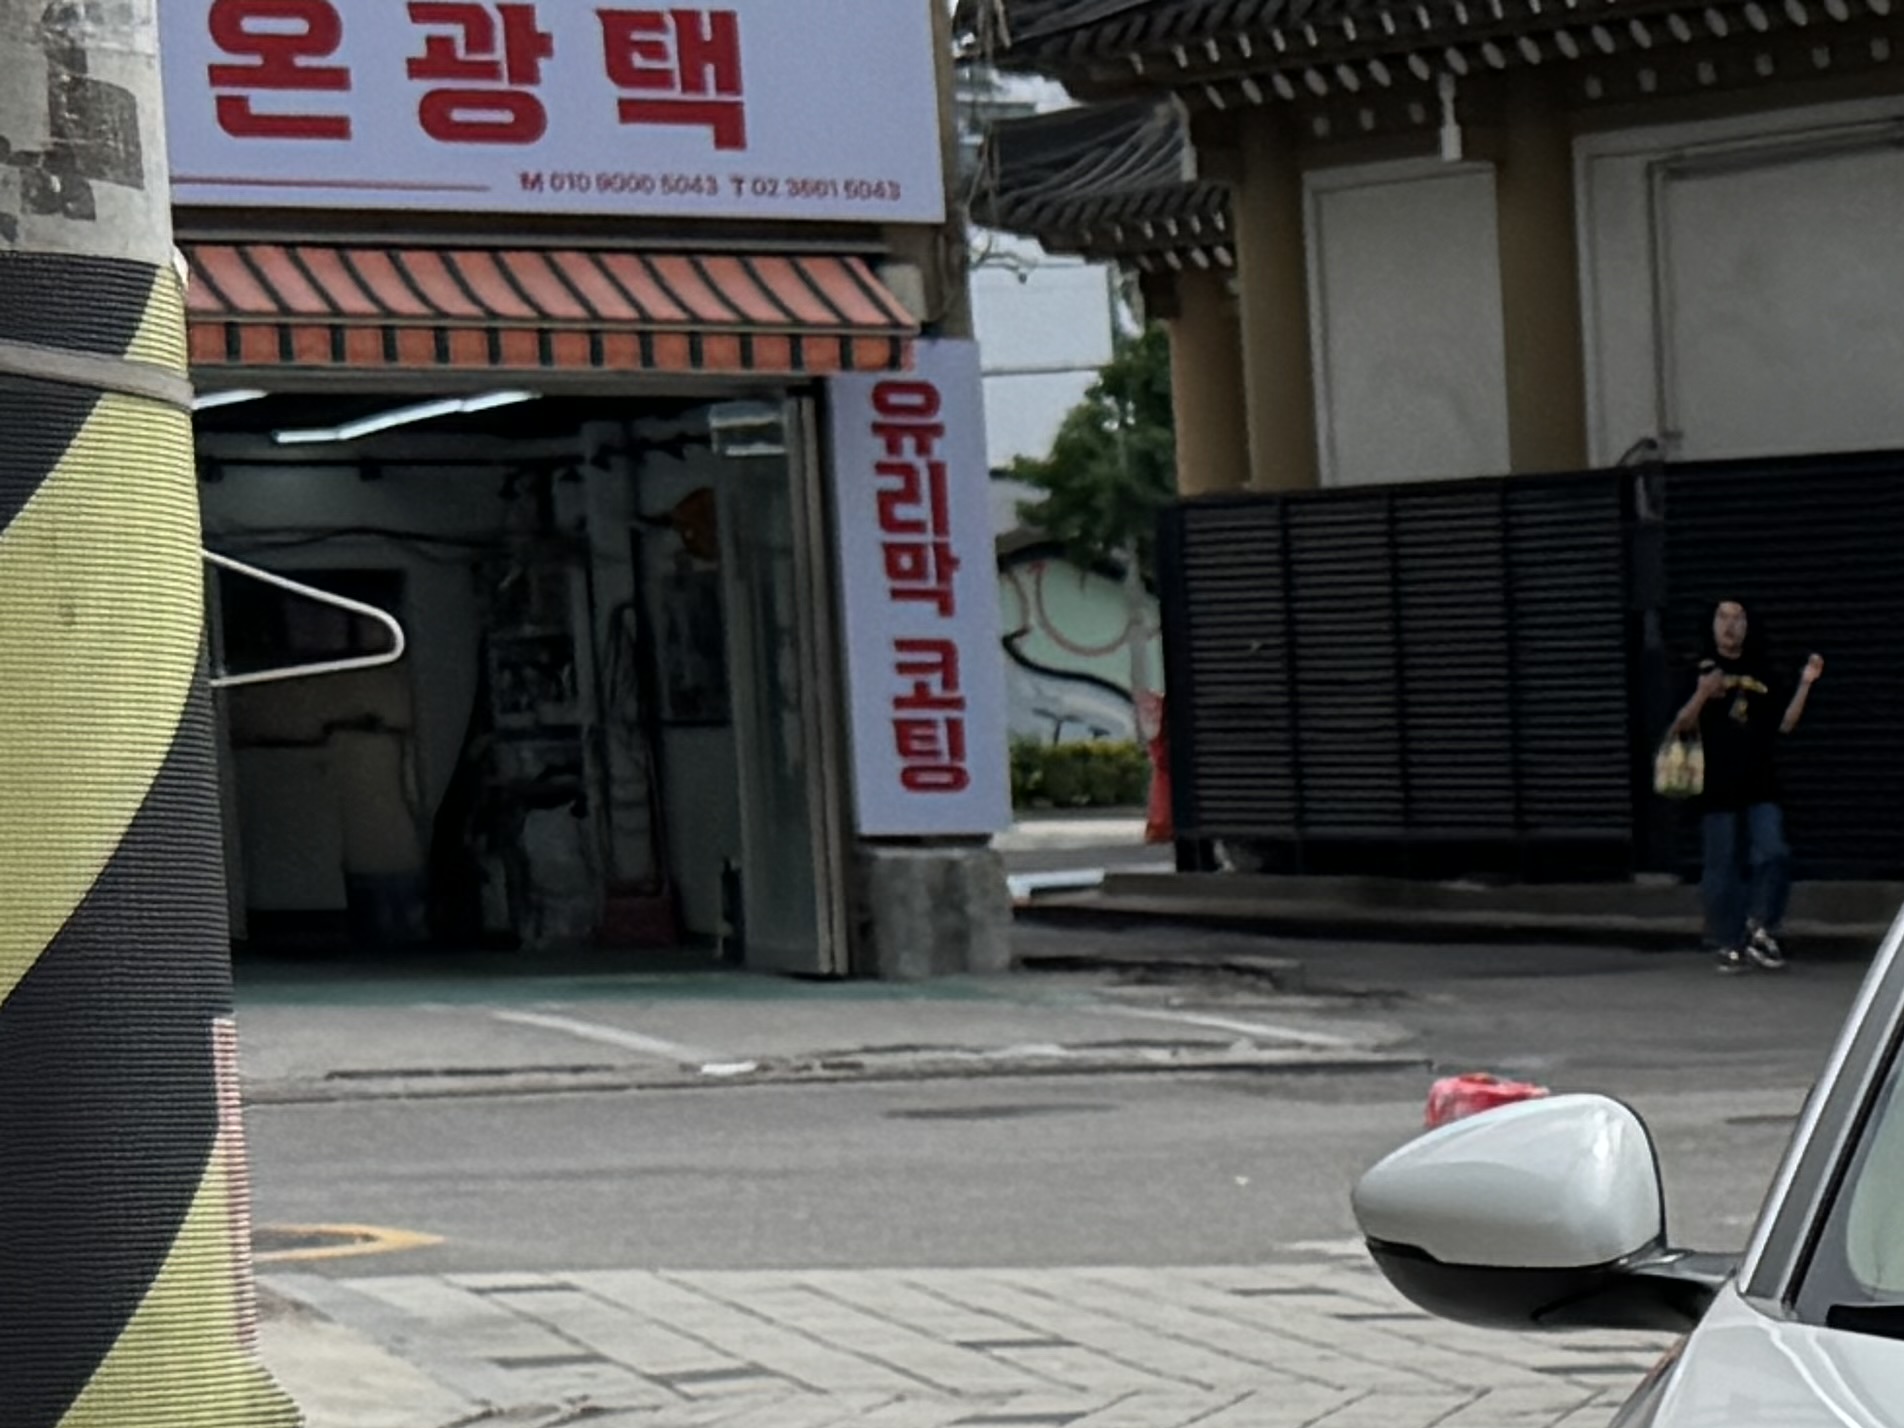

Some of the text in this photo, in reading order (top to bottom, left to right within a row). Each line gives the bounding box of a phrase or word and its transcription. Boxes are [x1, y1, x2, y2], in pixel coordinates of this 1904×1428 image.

[550, 172, 590, 194] 010
[728, 174, 745, 197] T
[751, 175, 778, 197] 02
[870, 379, 971, 793] 유리막 코팅
